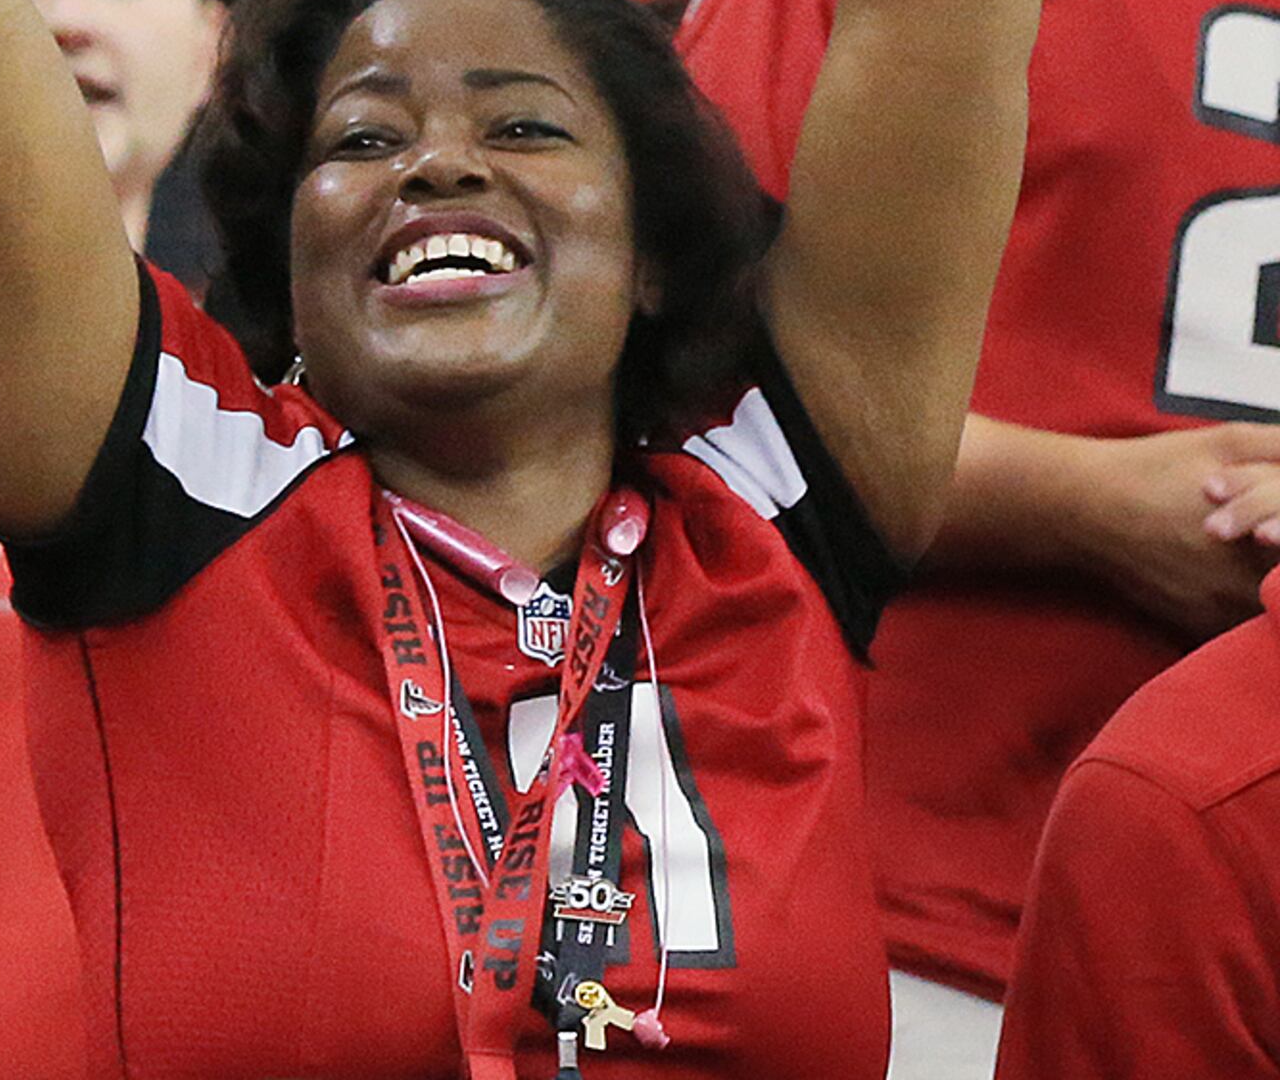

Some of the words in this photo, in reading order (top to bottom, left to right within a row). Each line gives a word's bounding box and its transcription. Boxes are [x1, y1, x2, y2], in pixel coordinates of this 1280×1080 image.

[462, 759, 498, 832] TICKET
[589, 797, 609, 864] TICKET
[496, 800, 545, 902] RISE
[569, 879, 612, 911] 50
[482, 918, 527, 991] UP
